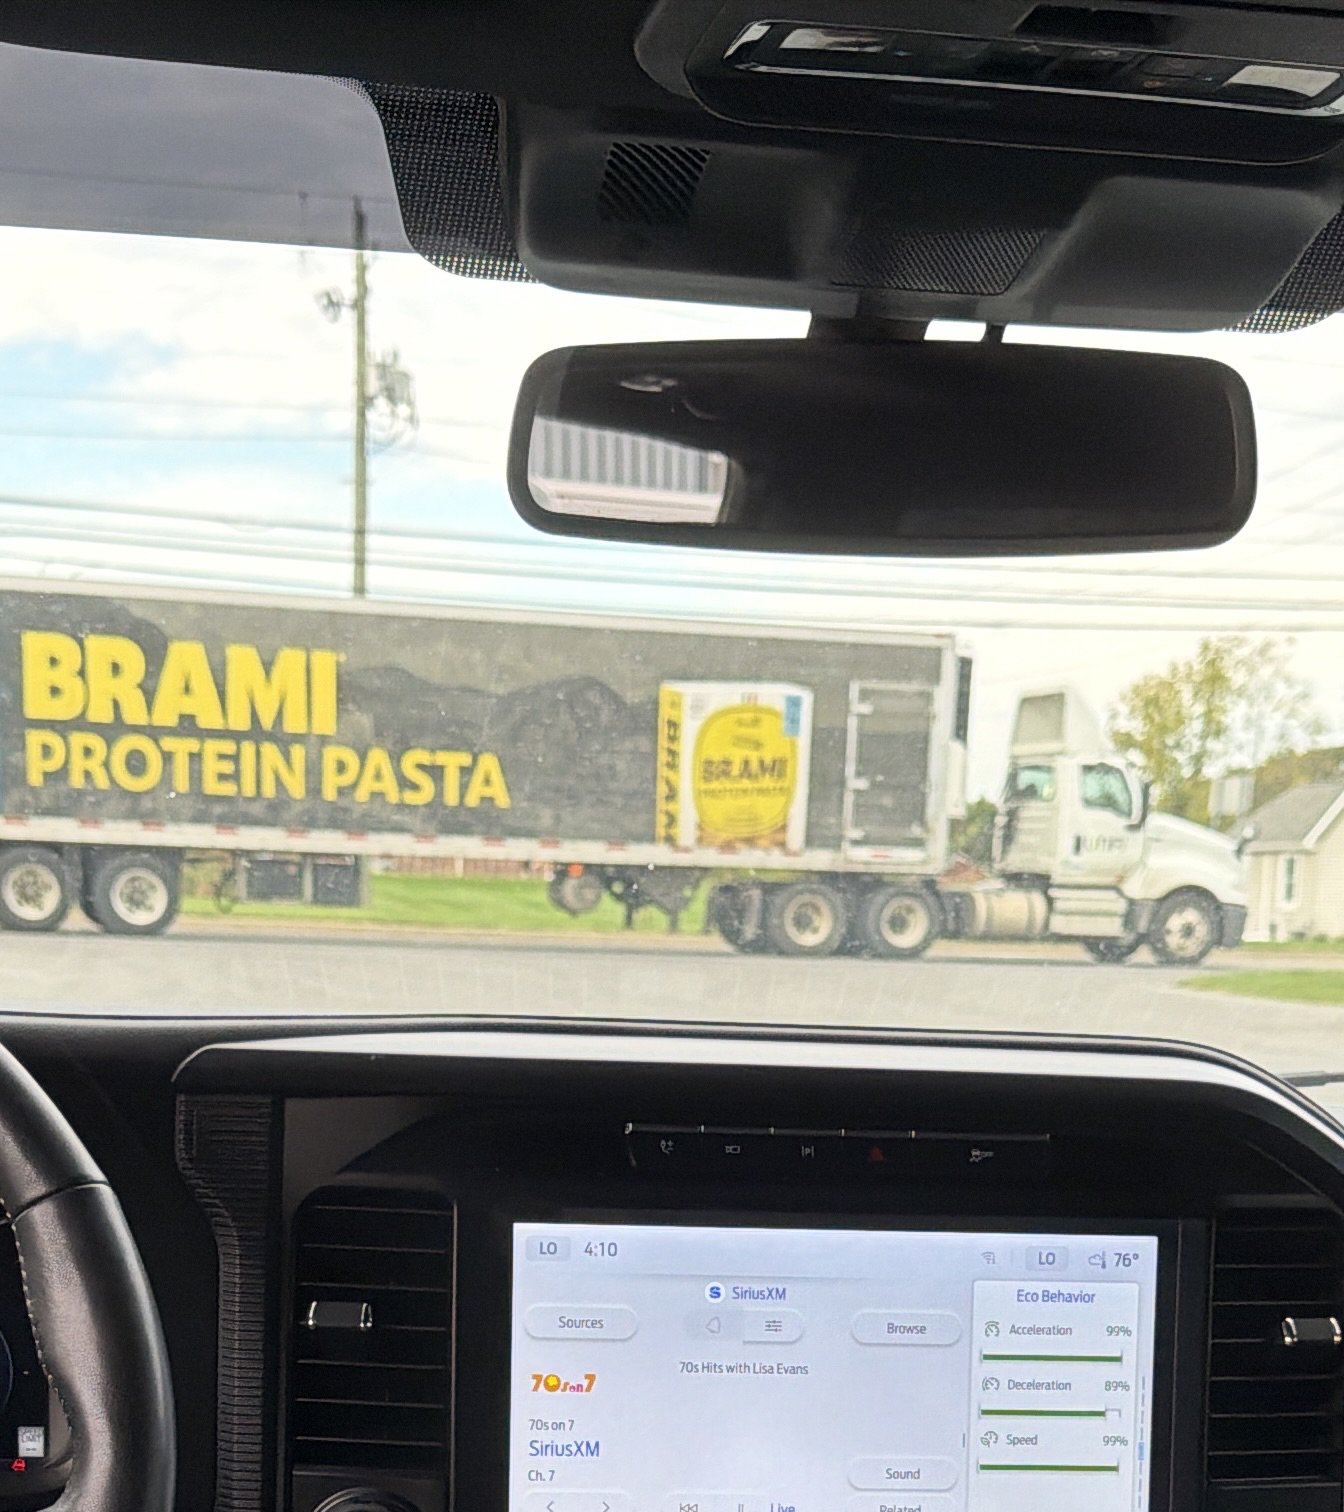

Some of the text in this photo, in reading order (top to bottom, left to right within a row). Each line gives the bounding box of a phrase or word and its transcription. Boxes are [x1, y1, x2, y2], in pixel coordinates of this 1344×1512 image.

[19, 628, 340, 738] BRAMI
[25, 728, 511, 810] PROTEIN PASTA
[540, 1242, 557, 1255] LO
[584, 1242, 617, 1256] 4:10
[1039, 1252, 1055, 1265] LO
[1114, 1253, 1139, 1267] 76°
[732, 1287, 786, 1300] SiriusXM
[1017, 1289, 1095, 1303] Eco Behavior
[559, 1316, 604, 1328] Sources
[887, 1323, 926, 1335] Browse
[1009, 1324, 1132, 1336] Acceleration 99%
[680, 1362, 808, 1375] 70s Hits with Lisa Evans
[1008, 1379, 1130, 1391] Deceleration 89%
[529, 1419, 574, 1431] 70s on 7
[1006, 1434, 1128, 1446] Speed 99%
[529, 1440, 599, 1457] SiriusXM
[528, 1470, 555, 1481] Ch. 7
[886, 1468, 920, 1479] Sound
